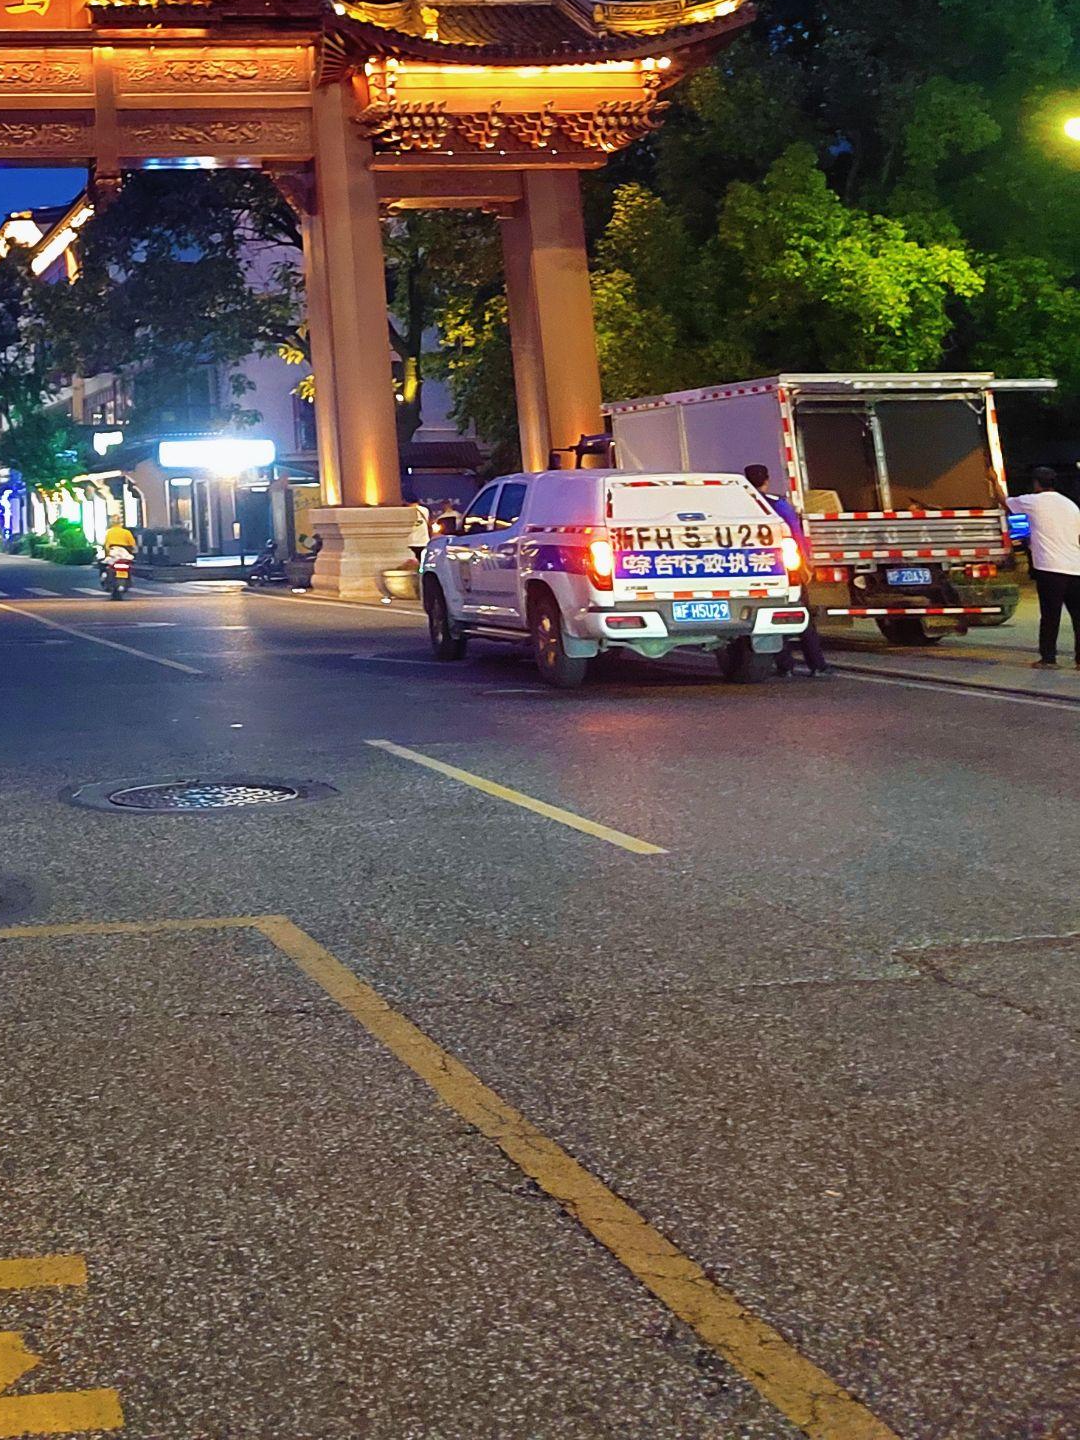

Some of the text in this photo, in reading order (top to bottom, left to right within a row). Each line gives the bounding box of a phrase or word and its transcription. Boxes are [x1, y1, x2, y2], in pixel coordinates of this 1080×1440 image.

[622, 552, 776, 575] 综合行政执法
